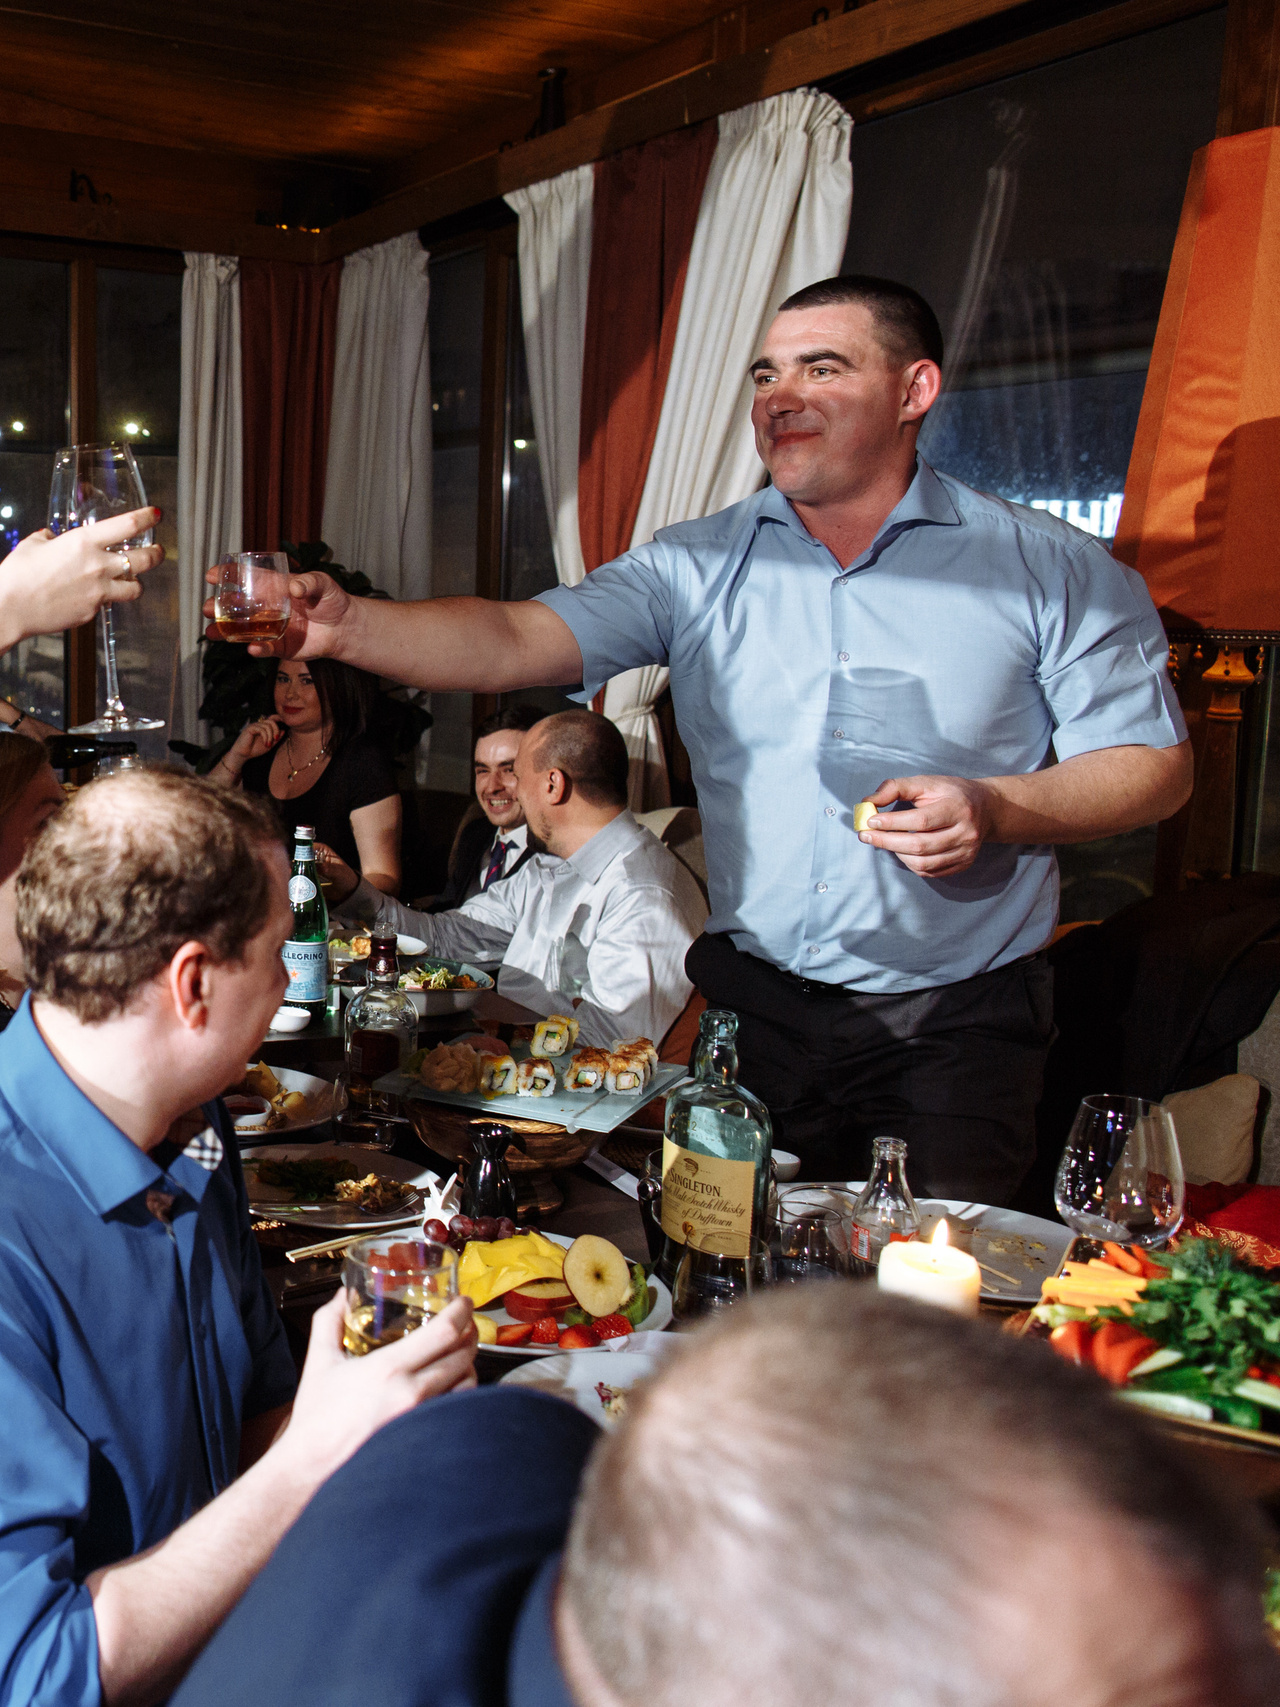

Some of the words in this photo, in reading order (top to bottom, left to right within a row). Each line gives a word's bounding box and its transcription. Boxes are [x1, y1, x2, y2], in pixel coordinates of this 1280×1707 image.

[669, 1167, 721, 1198] SINGLETON
[681, 1207, 691, 1219] of
[691, 1210, 733, 1227] Dufftown
[687, 1192, 713, 1210] Scotch
[713, 1199, 746, 1218] Whisky
